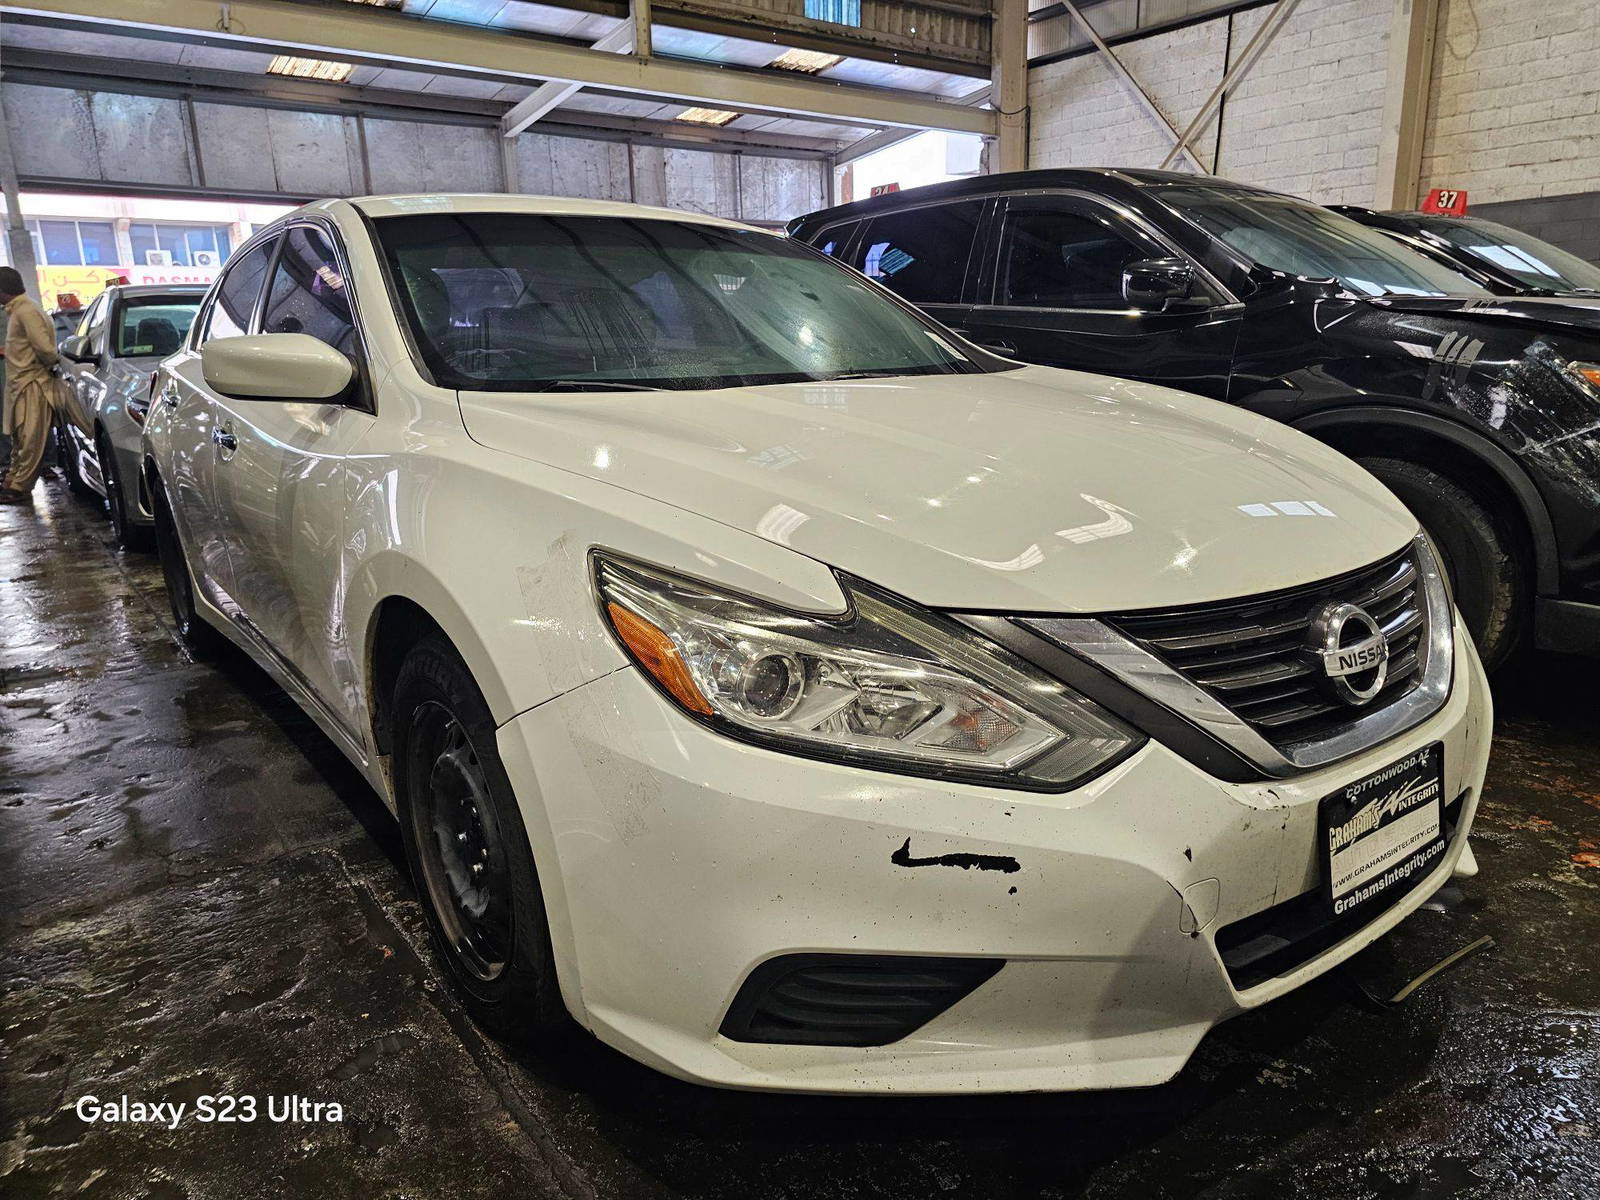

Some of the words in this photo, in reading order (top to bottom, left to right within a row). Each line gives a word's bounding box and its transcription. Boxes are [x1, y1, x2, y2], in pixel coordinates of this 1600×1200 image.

[1437, 190, 1458, 209] 37
[1398, 782, 1439, 813] INTEGRITY
[1334, 839, 1445, 915] GrahamsIntegrity.com
